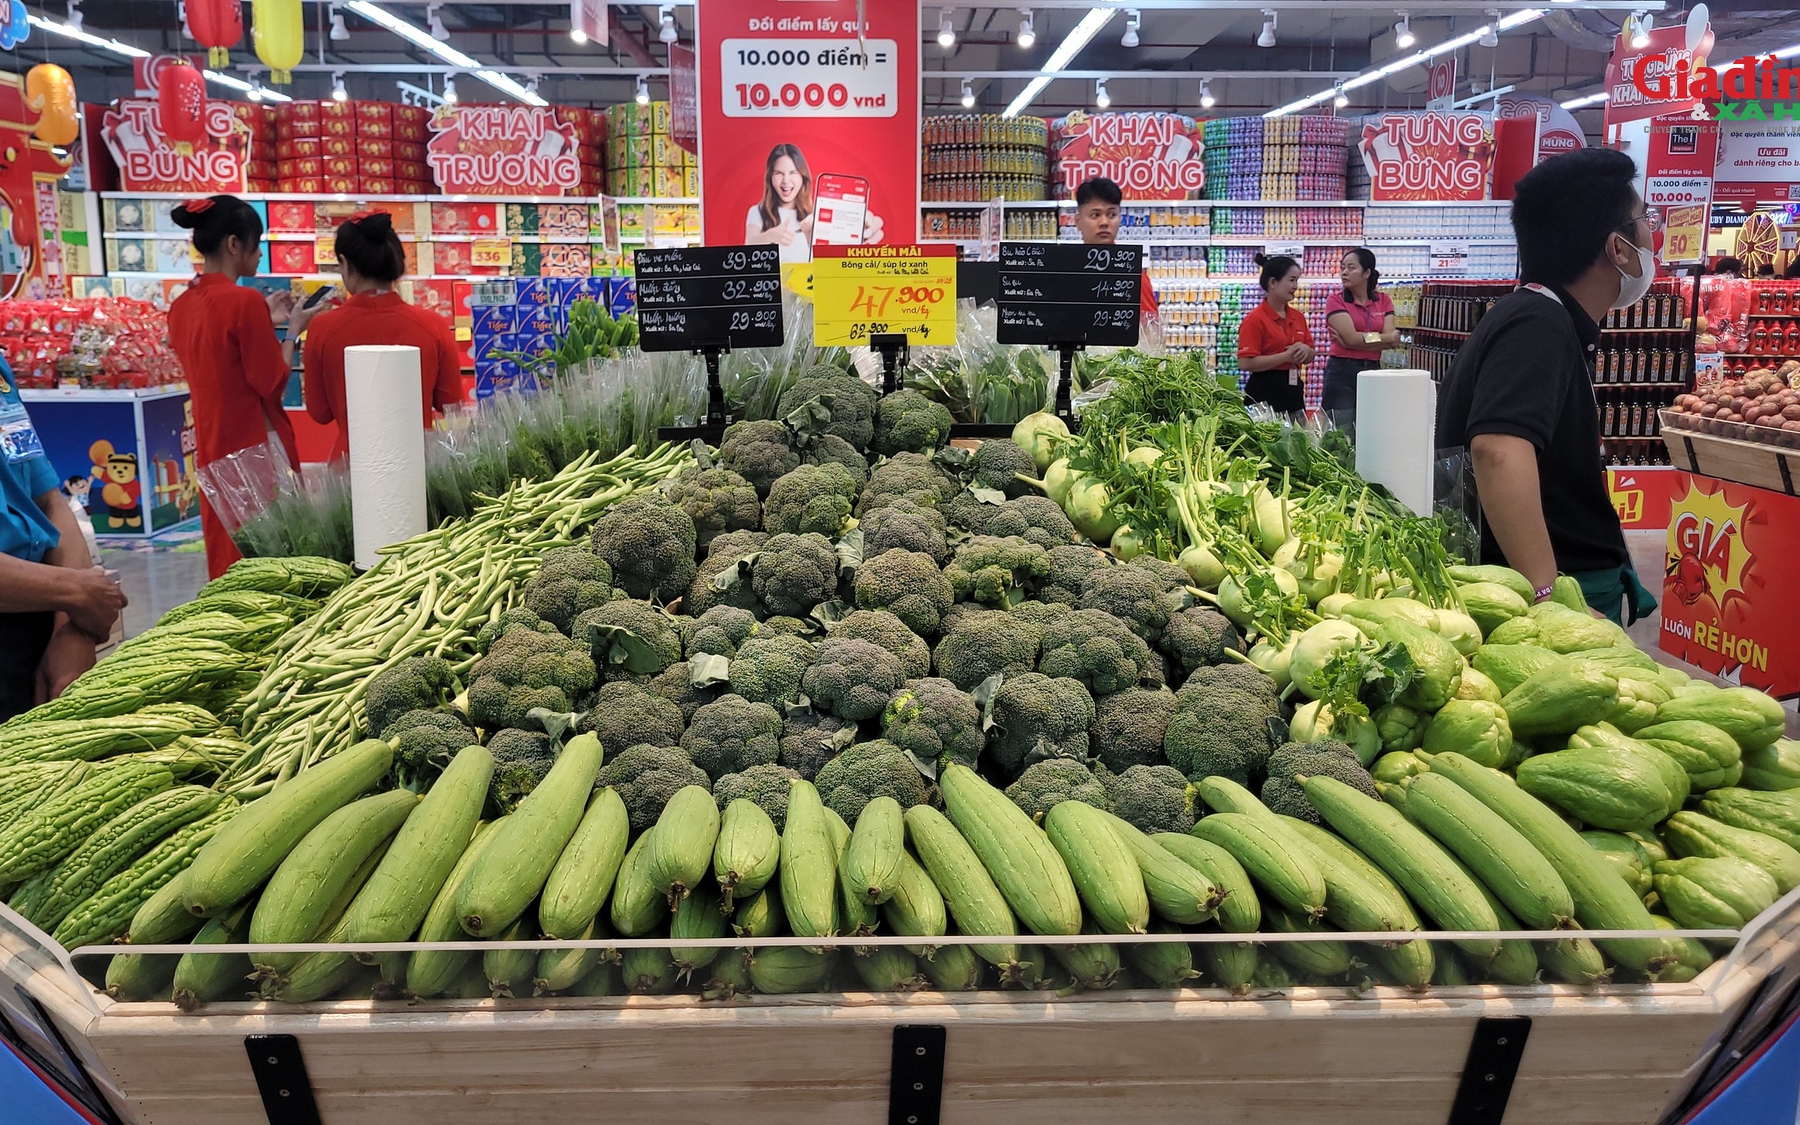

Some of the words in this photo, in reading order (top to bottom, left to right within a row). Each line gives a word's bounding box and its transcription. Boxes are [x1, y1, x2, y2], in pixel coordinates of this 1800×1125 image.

[749, 16, 773, 31] Đổi
[777, 16, 813, 31] điểm
[817, 17, 838, 33] lấy
[842, 20, 869, 33] qu
[738, 50, 810, 66] 10.000
[817, 47, 868, 66] điểm
[735, 83, 848, 109] 10.000
[853, 94, 886, 107] vnd
[122, 103, 234, 136] TG
[461, 108, 545, 141] KHAI
[1382, 111, 1484, 146] TƯNG
[1092, 114, 1174, 146] KHAI
[128, 143, 238, 181] BỪNG
[427, 152, 580, 187] TRƯƠNG
[1379, 156, 1482, 190] BỪNG
[1653, 180, 1680, 188] 10.000
[1681, 179, 1701, 188] điểm
[1651, 193, 1692, 202] 10.000
[1711, 215, 1724, 224] UBY
[847, 244, 897, 257] KHUYẾN
[899, 245, 922, 257] MÃI
[1669, 234, 1688, 255] 50
[475, 251, 501, 262] 336
[722, 250, 778, 270] 39.000
[841, 261, 863, 269] Bông
[882, 261, 897, 270] súp
[1083, 248, 1136, 271] 29.900
[1438, 259, 1449, 267] 21
[625, 292, 637, 303] Tig
[722, 280, 780, 300] 32.900
[1091, 280, 1135, 298] 14.900
[849, 285, 945, 318] 47.900
[487, 320, 508, 332] Tiger
[729, 310, 777, 330] 29.900
[1092, 310, 1134, 327] 29.900
[1675, 512, 1737, 585] GIÁ
[1664, 617, 1691, 640] LUÔN
[1694, 616, 1719, 652] RẺ
[1721, 633, 1769, 672] HƠN
